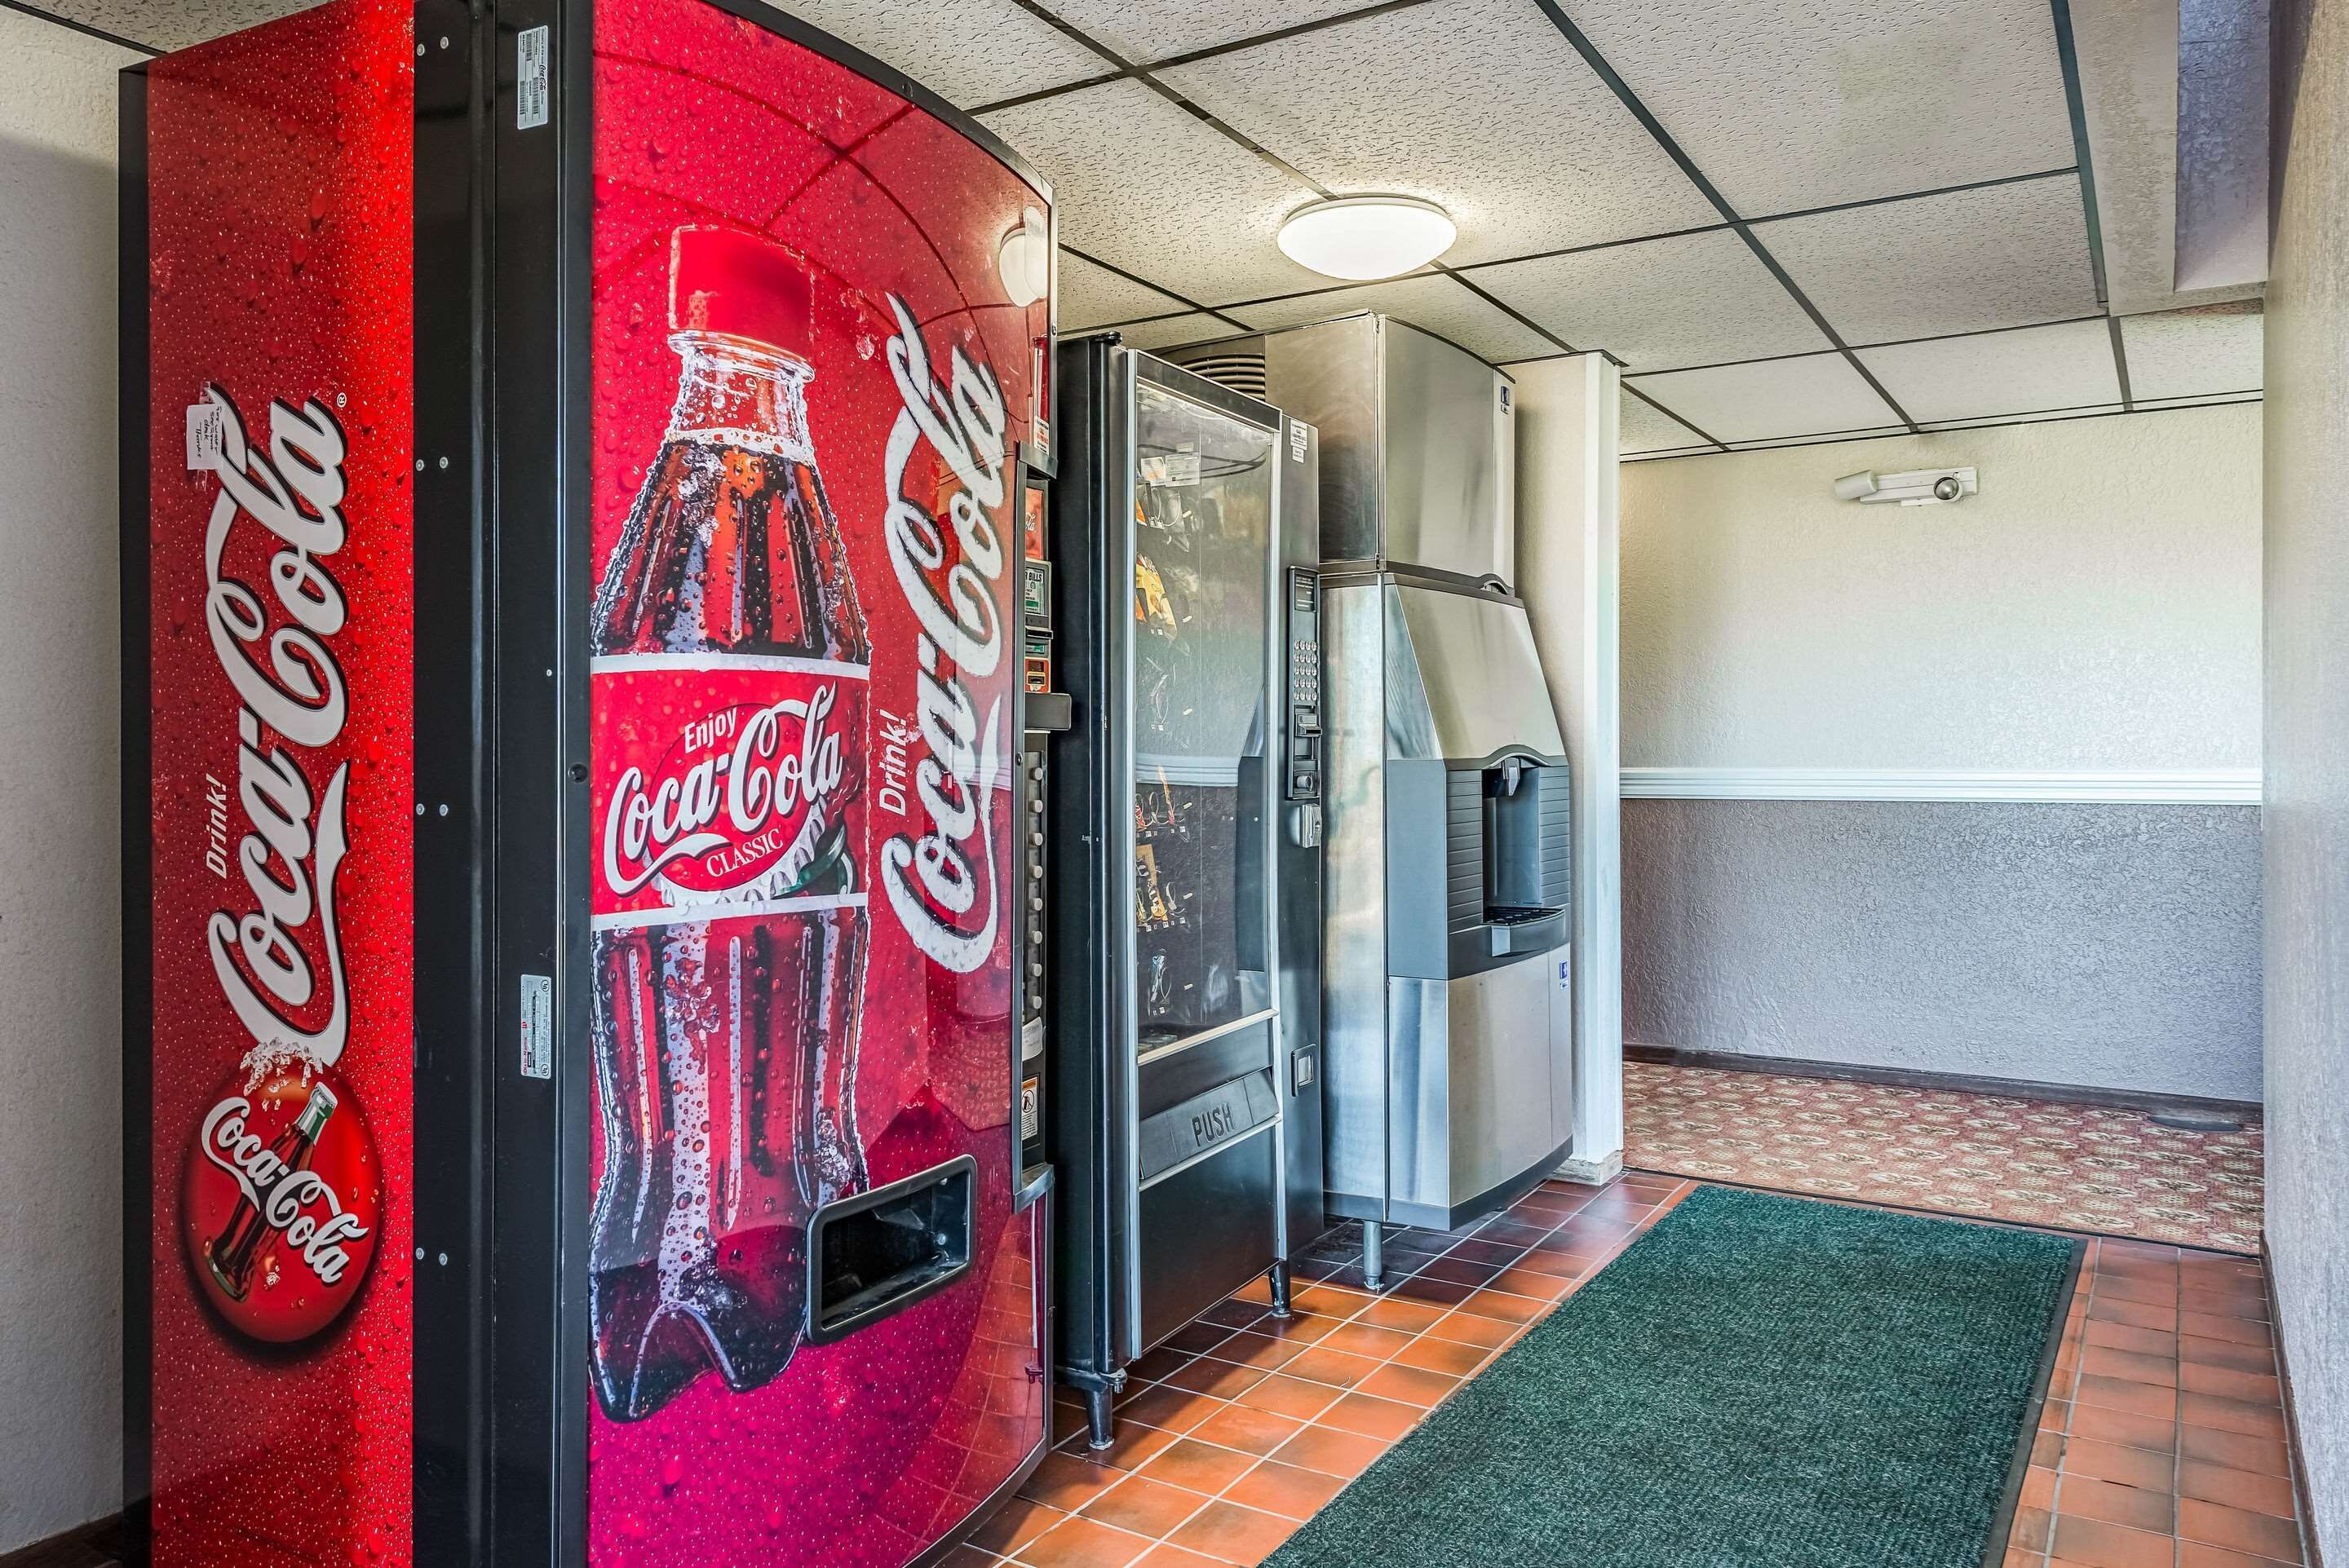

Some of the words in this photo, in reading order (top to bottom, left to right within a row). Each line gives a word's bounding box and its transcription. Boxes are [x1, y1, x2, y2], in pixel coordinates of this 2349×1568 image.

[881, 292, 1006, 975] Coca-Cola
[206, 381, 347, 1067] Coca-Cola
[684, 706, 738, 754] Enjoy
[878, 709, 906, 816] Drink!
[206, 774, 230, 880] Drink!
[604, 679, 843, 896] Coca-Cola
[706, 828, 783, 877] CLASSIC
[1191, 1102, 1235, 1147] PUSH
[201, 1097, 369, 1284] Coca-Cola
